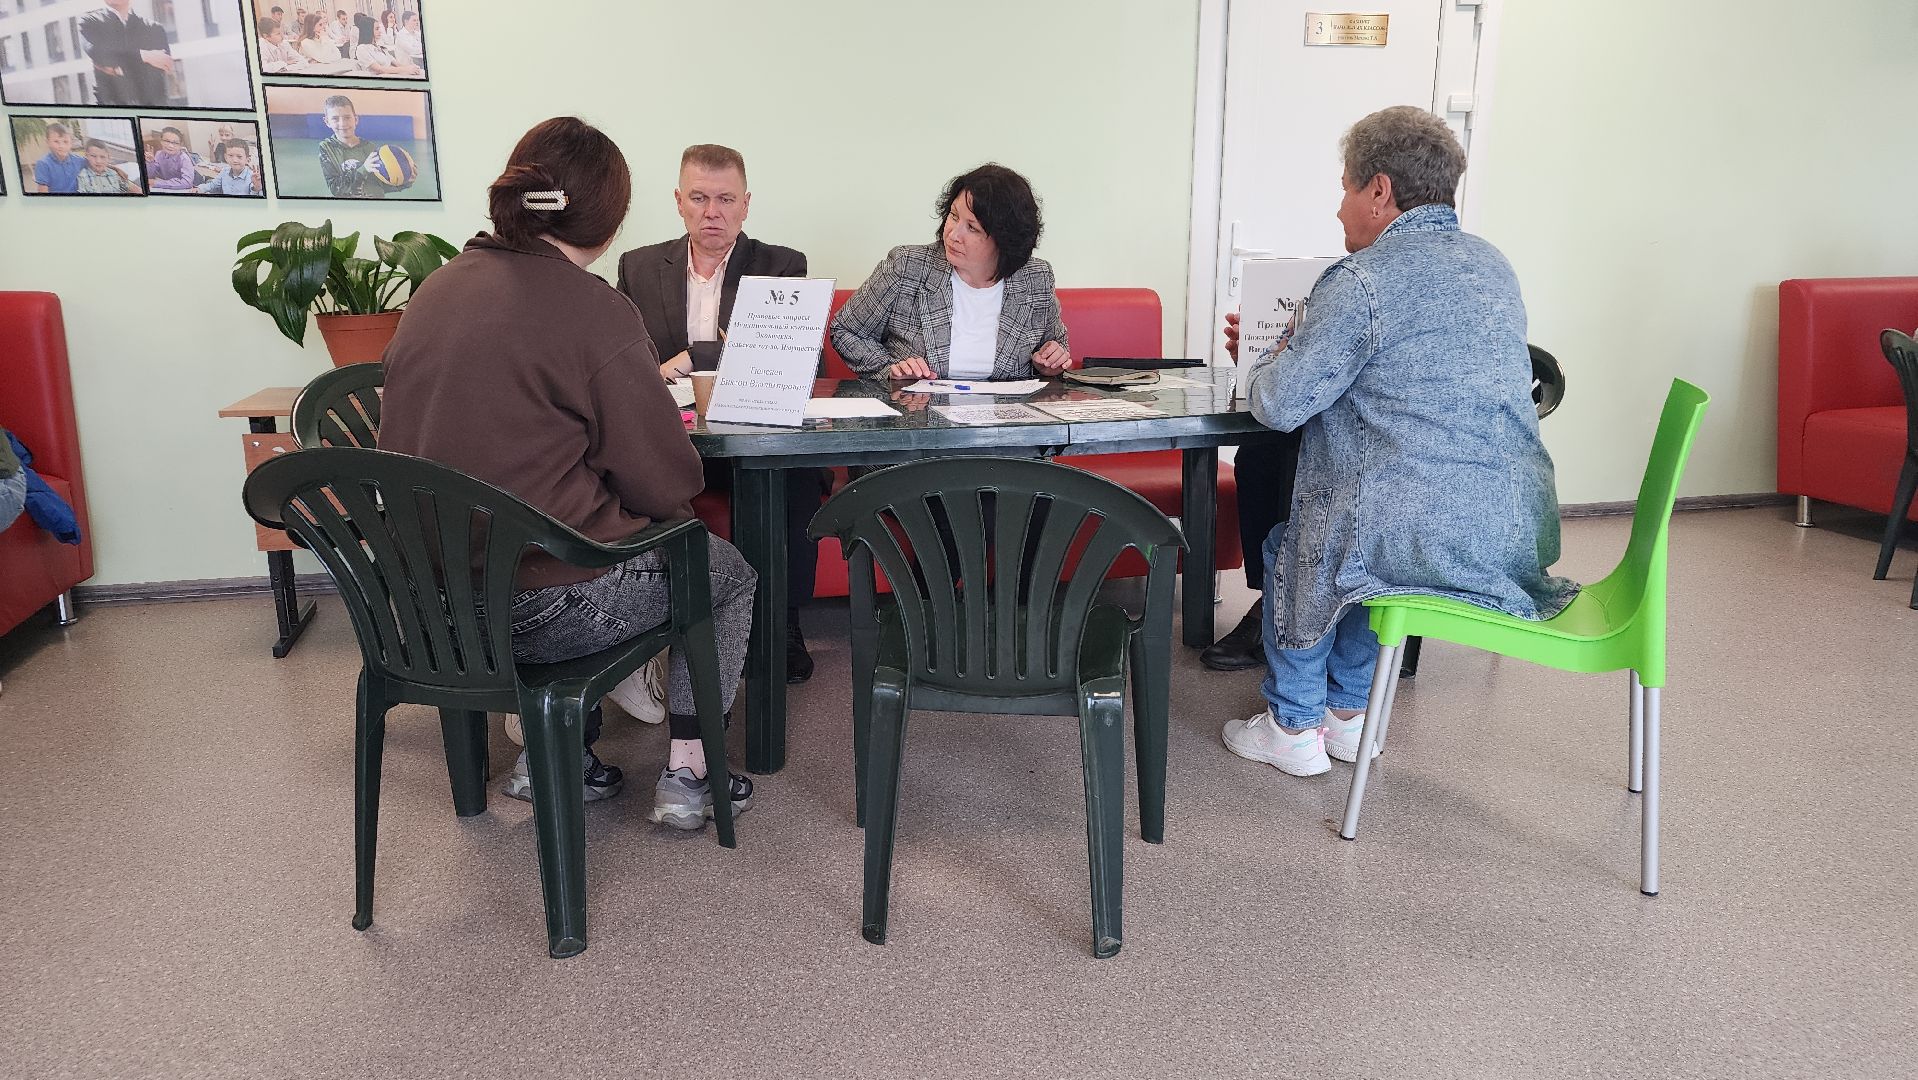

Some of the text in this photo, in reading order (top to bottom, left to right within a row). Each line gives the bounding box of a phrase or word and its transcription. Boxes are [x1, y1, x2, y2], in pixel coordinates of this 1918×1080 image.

[1315, 21, 1323, 35] 3
[765, 290, 800, 305] № 5
[1274, 297, 1294, 311] №
